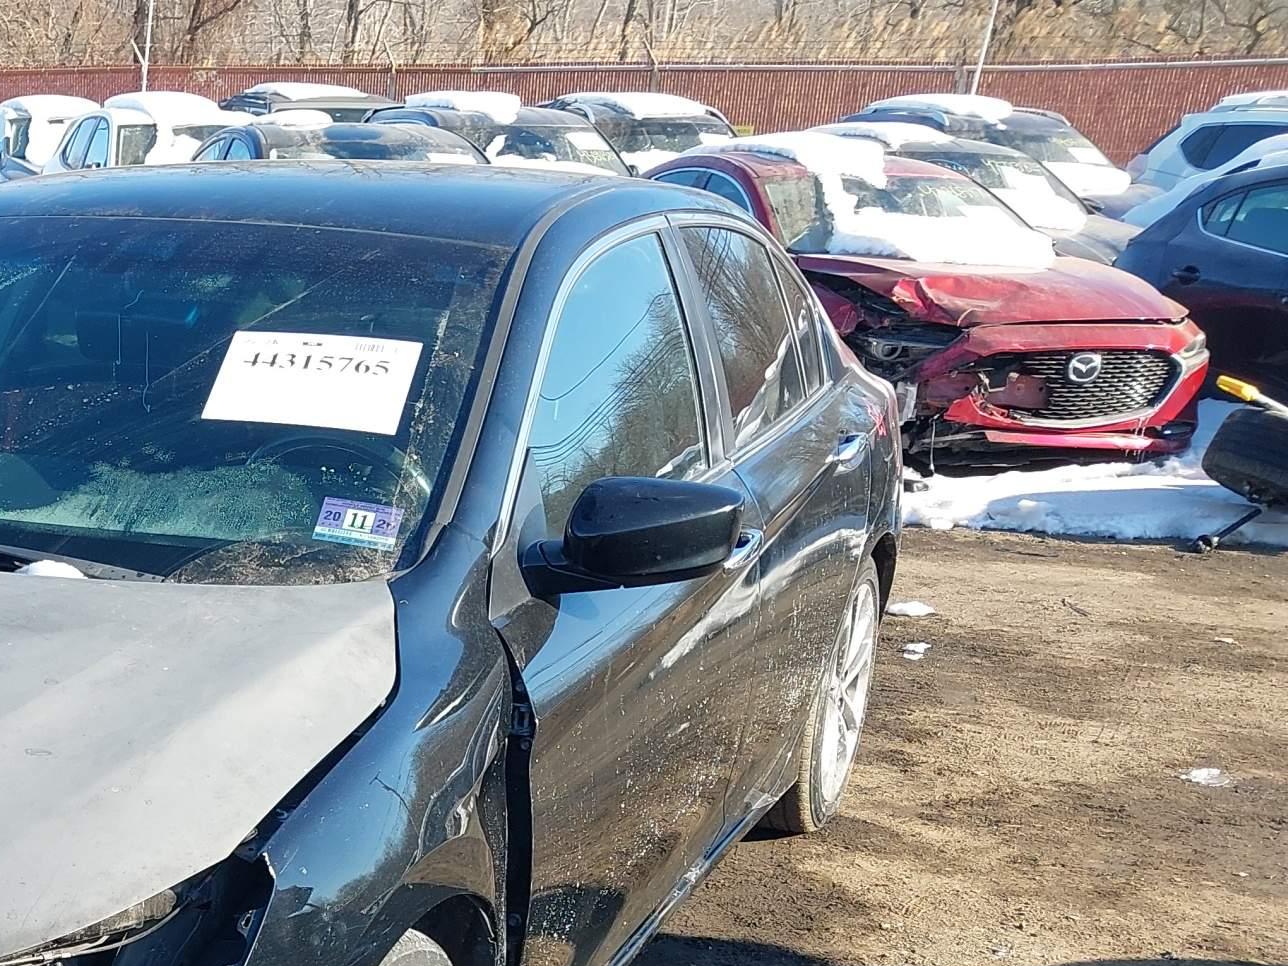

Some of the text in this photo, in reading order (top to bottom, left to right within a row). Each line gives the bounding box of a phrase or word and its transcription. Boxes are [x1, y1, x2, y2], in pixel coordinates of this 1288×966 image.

[242, 351, 392, 376] 44315765
[323, 510, 342, 522] 20
[347, 512, 369, 530] 11
